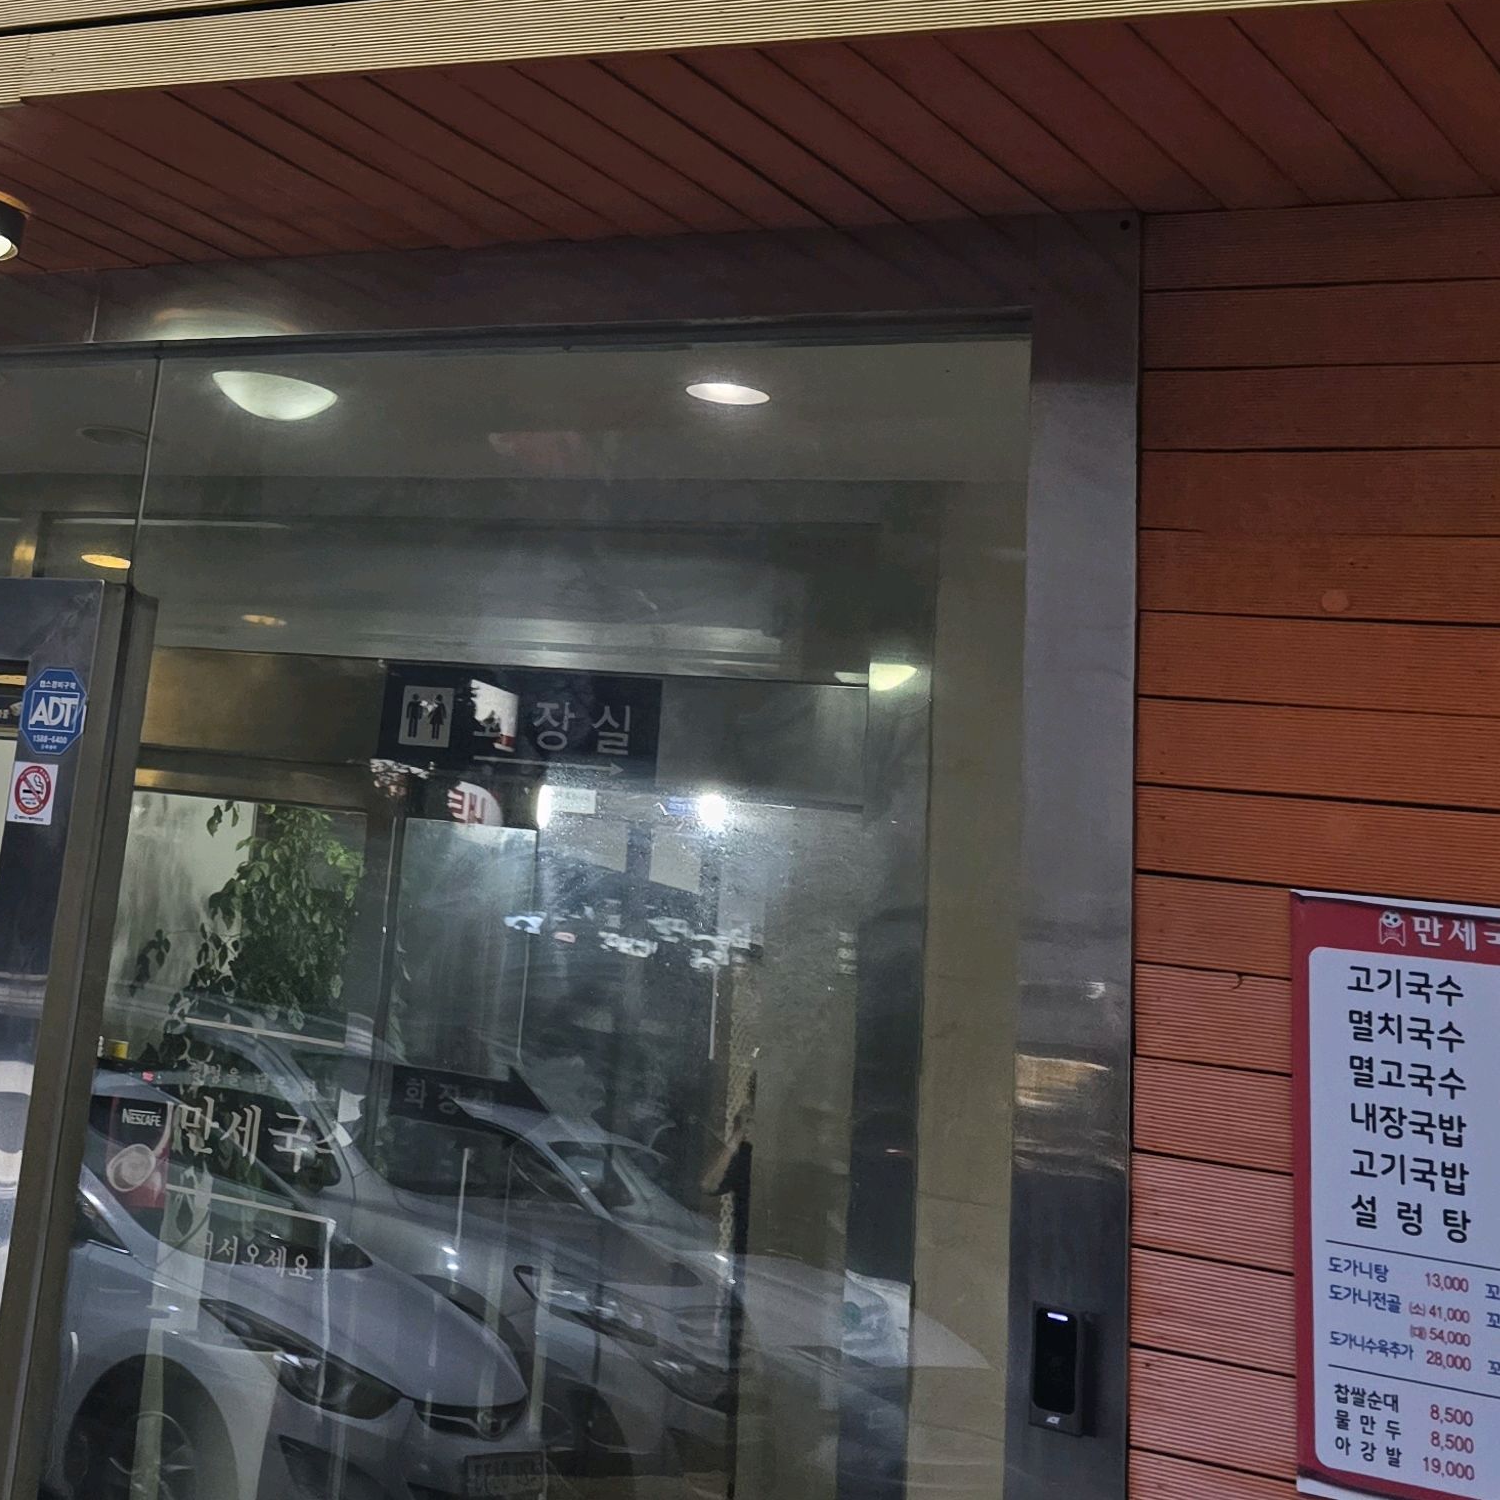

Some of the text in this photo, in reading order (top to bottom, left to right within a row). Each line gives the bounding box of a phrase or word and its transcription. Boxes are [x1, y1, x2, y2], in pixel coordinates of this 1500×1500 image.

[29, 696, 80, 727] ADT
[1347, 965, 1464, 1007] 고기국수
[1348, 1009, 1465, 1053] 멸치국수
[1349, 1055, 1467, 1100] 멸고국수
[1350, 1102, 1467, 1148] 내장국밥
[1350, 1148, 1470, 1197] 고기국밥
[1328, 1256, 1389, 1283] 도가니탕
[1425, 1271, 1470, 1293] 13,000
[1328, 1284, 1402, 1314] 도가니전골
[1428, 1304, 1470, 1324] 41,000
[1329, 1331, 1414, 1361] 도가니수육추가
[1426, 1350, 1472, 1372] 28,000
[1429, 1327, 1471, 1347] 54,000
[1334, 1383, 1474, 1427] 찹쌀순대 8,500
[1430, 1430, 1475, 1454] 8,500
[1422, 1456, 1475, 1481] 19,000
